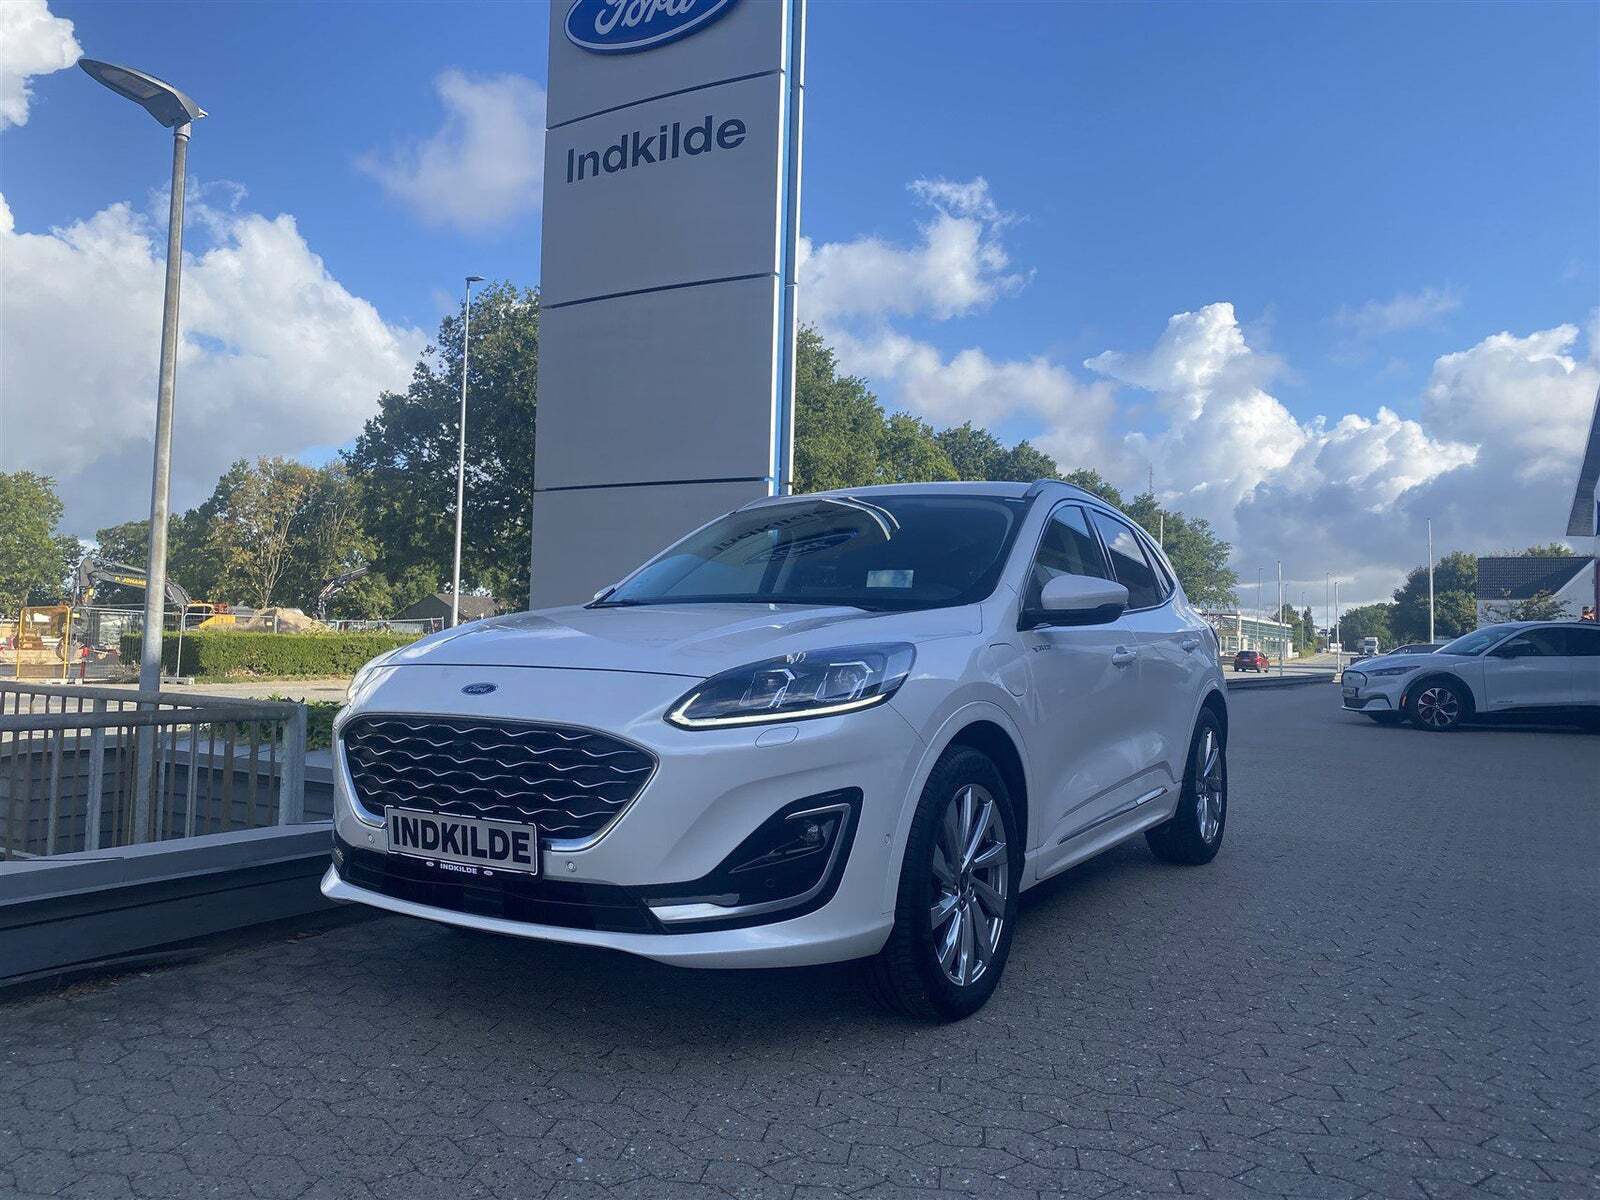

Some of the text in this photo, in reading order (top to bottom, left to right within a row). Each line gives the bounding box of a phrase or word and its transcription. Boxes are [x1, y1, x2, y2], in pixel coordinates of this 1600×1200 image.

[567, 115, 746, 183] Indkilde
[392, 815, 531, 864] INDKILDE
[440, 863, 477, 875] INDKILDE
